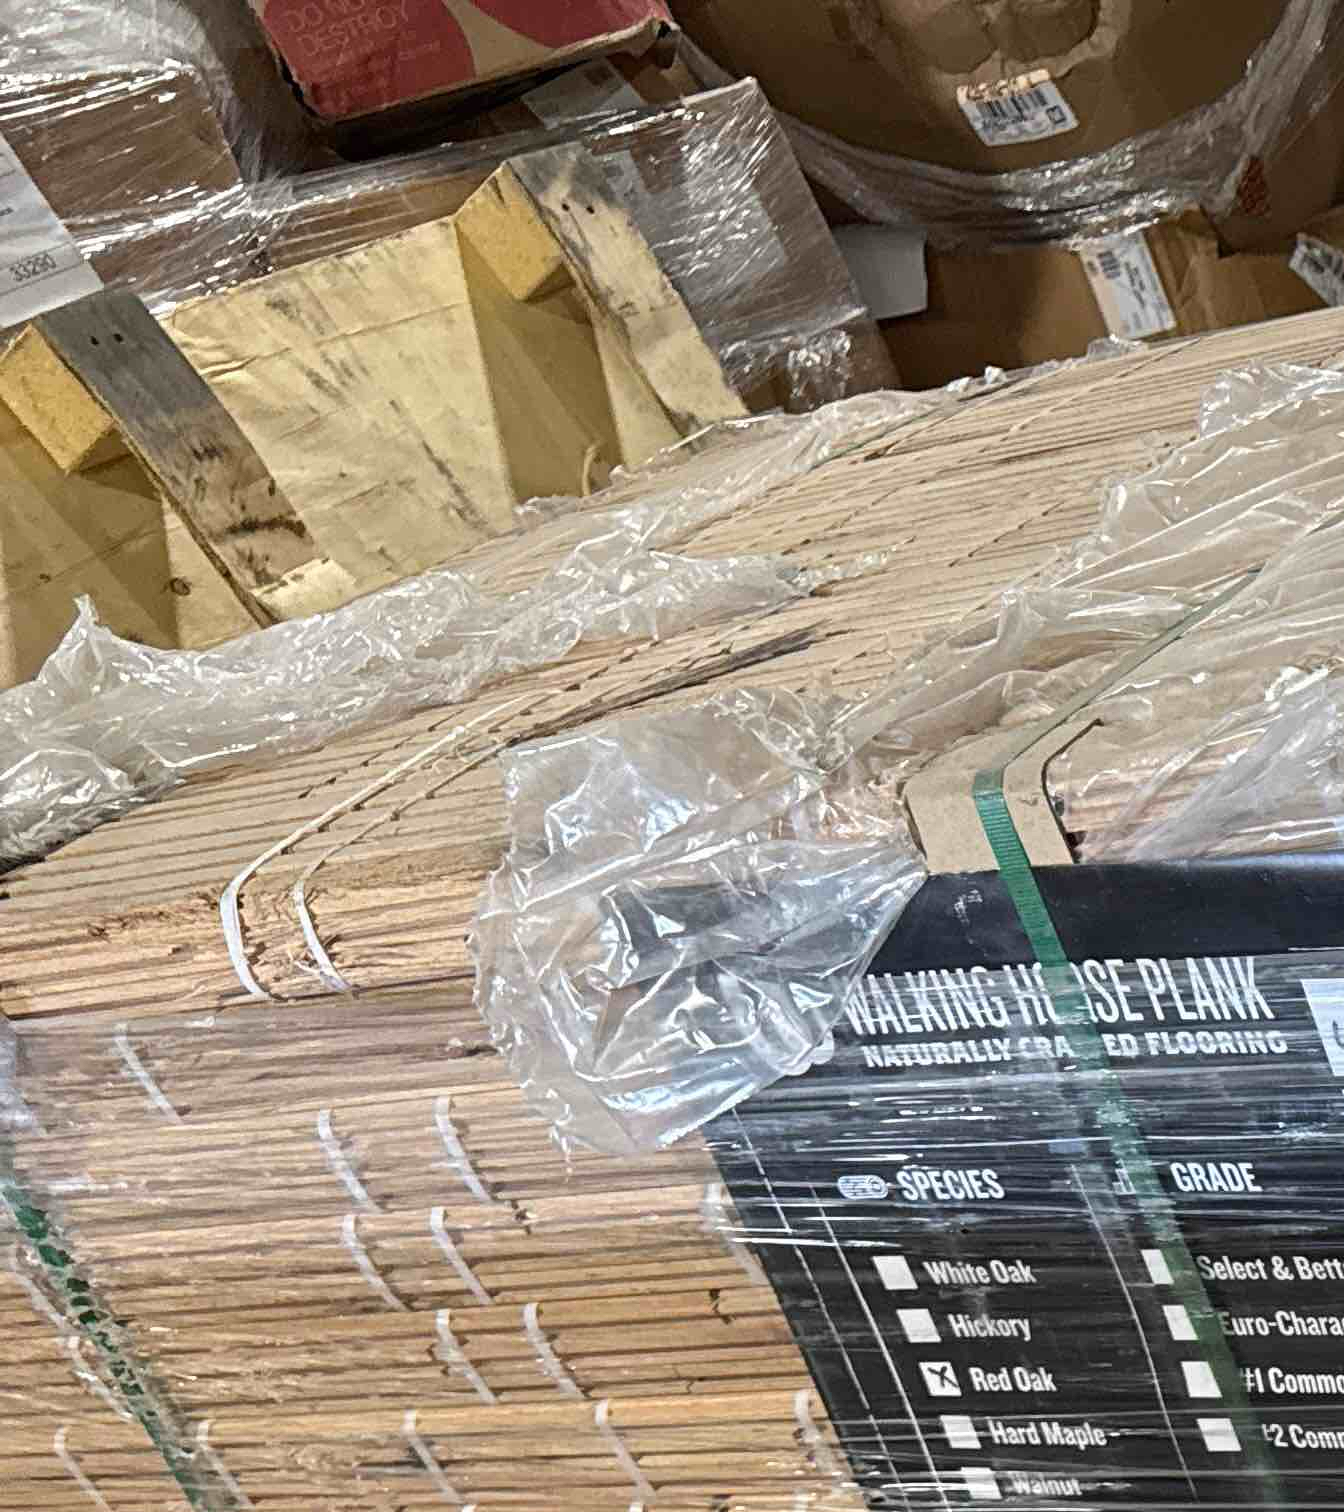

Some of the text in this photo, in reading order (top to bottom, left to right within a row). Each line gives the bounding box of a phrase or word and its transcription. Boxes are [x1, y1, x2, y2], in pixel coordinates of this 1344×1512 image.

[844, 966, 1010, 1036] WALKING
[1136, 955, 1276, 1021] PLANK
[862, 1029, 1289, 1068] NATURALLY CRAED FLOORING
[896, 1168, 1005, 1200] SPECIES
[1170, 1162, 1262, 1193] GRADE
[923, 1260, 1037, 1285] White Oak
[1197, 1255, 1268, 1281] Select
[1271, 1255, 1294, 1281] &
[948, 1313, 1031, 1342] Hickory
[969, 1366, 1057, 1392] Red Oak
[987, 1419, 1107, 1450] Hard Maple
[1012, 1476, 1083, 1496] Walnut
